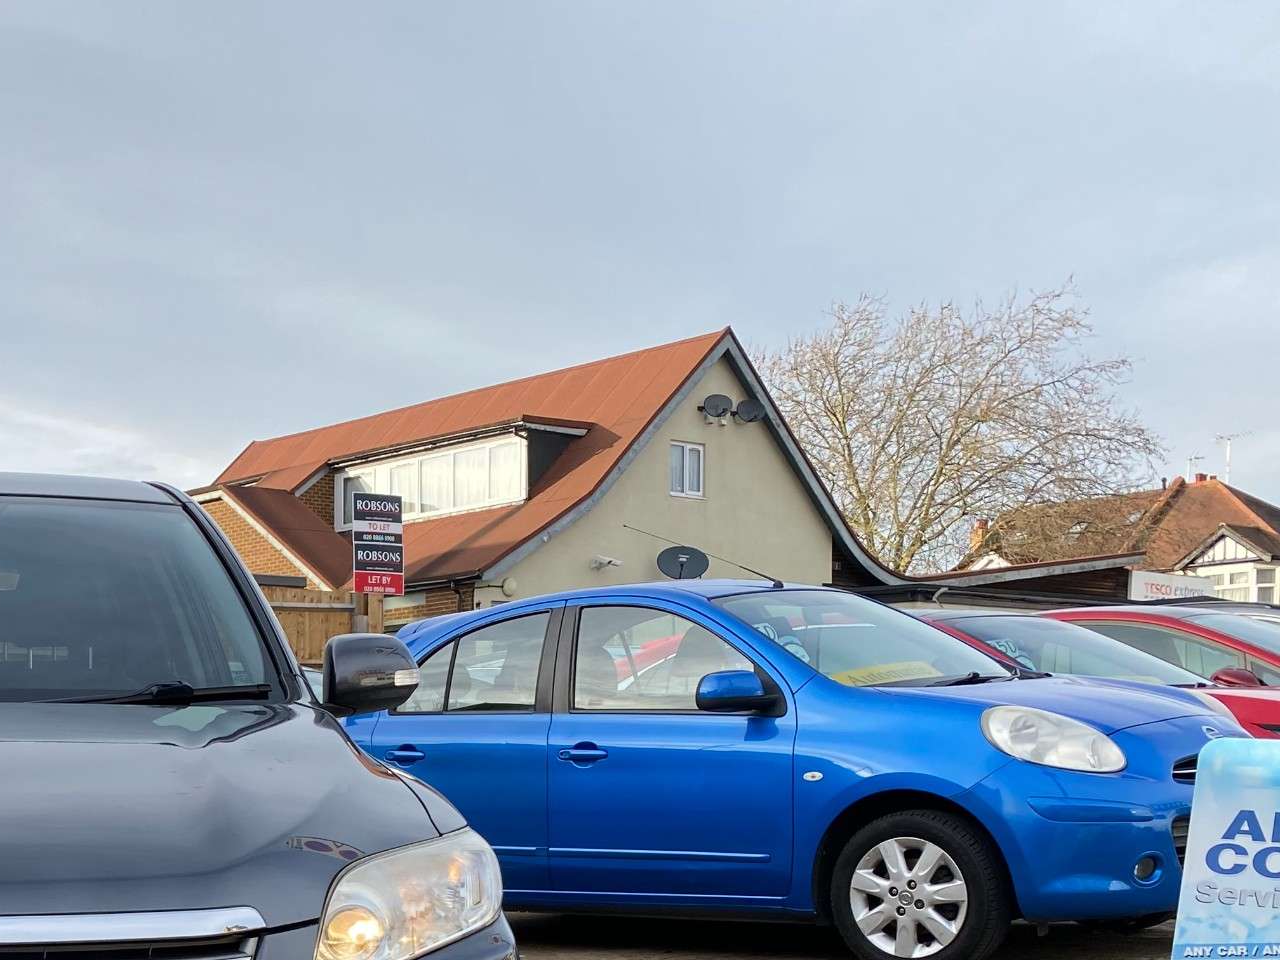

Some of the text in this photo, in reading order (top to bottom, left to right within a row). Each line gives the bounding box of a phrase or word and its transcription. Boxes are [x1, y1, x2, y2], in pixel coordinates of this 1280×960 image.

[357, 500, 400, 512] ROBSONS
[357, 550, 400, 562] ROBSONS
[368, 575, 391, 585] LET BY
[1144, 582, 1171, 597] TESCO
[1183, 945, 1214, 959] ANY
[1217, 945, 1248, 958] CAR
[1251, 945, 1260, 958] /
